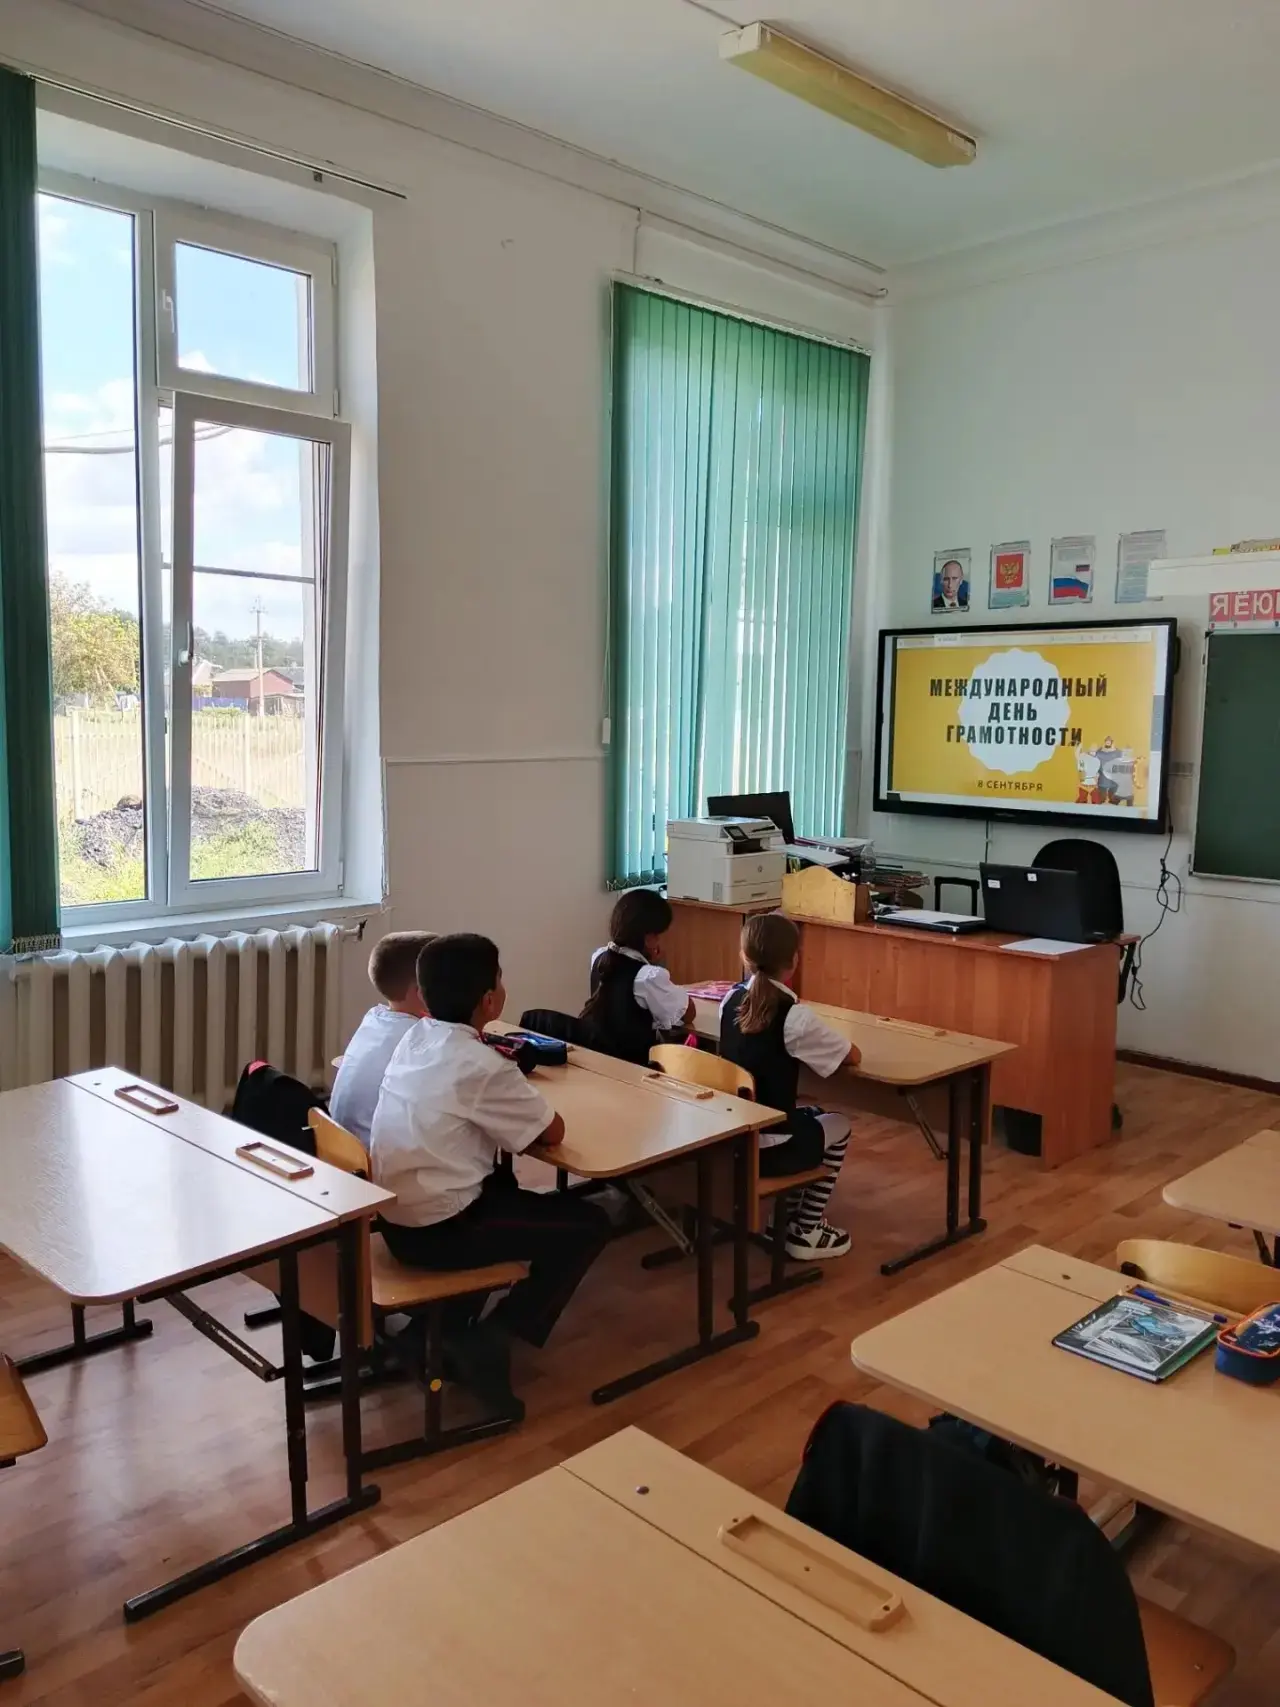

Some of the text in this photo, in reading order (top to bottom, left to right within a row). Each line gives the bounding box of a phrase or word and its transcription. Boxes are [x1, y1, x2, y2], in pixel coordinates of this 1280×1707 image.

[930, 673, 1107, 699] МЕЖДУНАРОДНЫЙ
[988, 702, 1037, 723] ДЕНЬ
[946, 725, 1082, 746] ГРАМОТНОСТИ
[977, 780, 1043, 791] 8 СЕНТЯБРЯ
